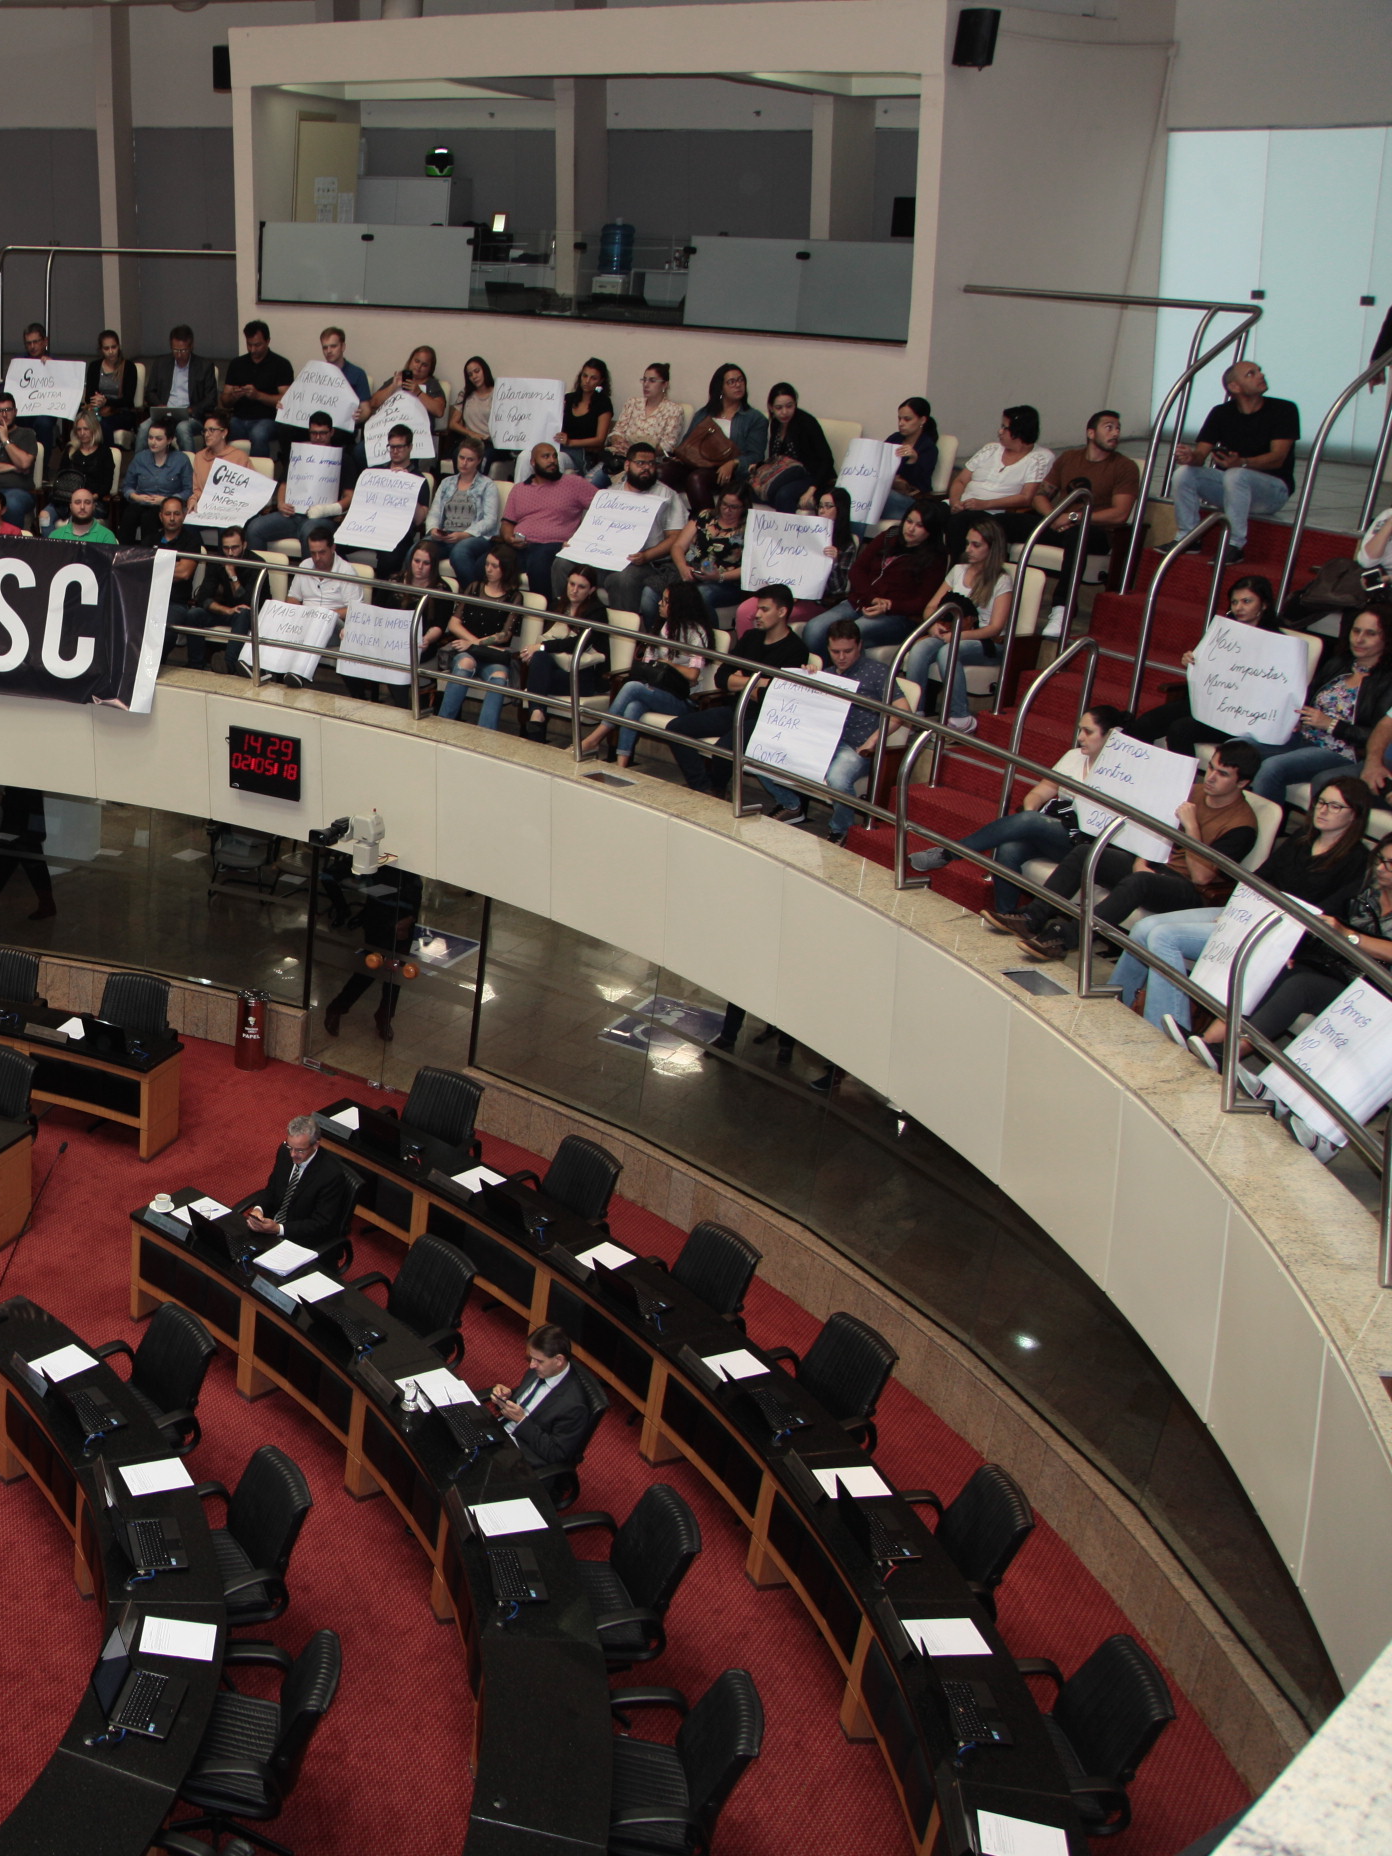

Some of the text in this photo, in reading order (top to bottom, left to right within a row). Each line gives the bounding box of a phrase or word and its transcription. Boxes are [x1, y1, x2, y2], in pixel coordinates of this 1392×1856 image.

[212, 464, 250, 488] CHEGA
[223, 486, 235, 496] DE
[269, 604, 296, 618] MAIS
[766, 708, 801, 730] PAGAR
[772, 731, 782, 741] A
